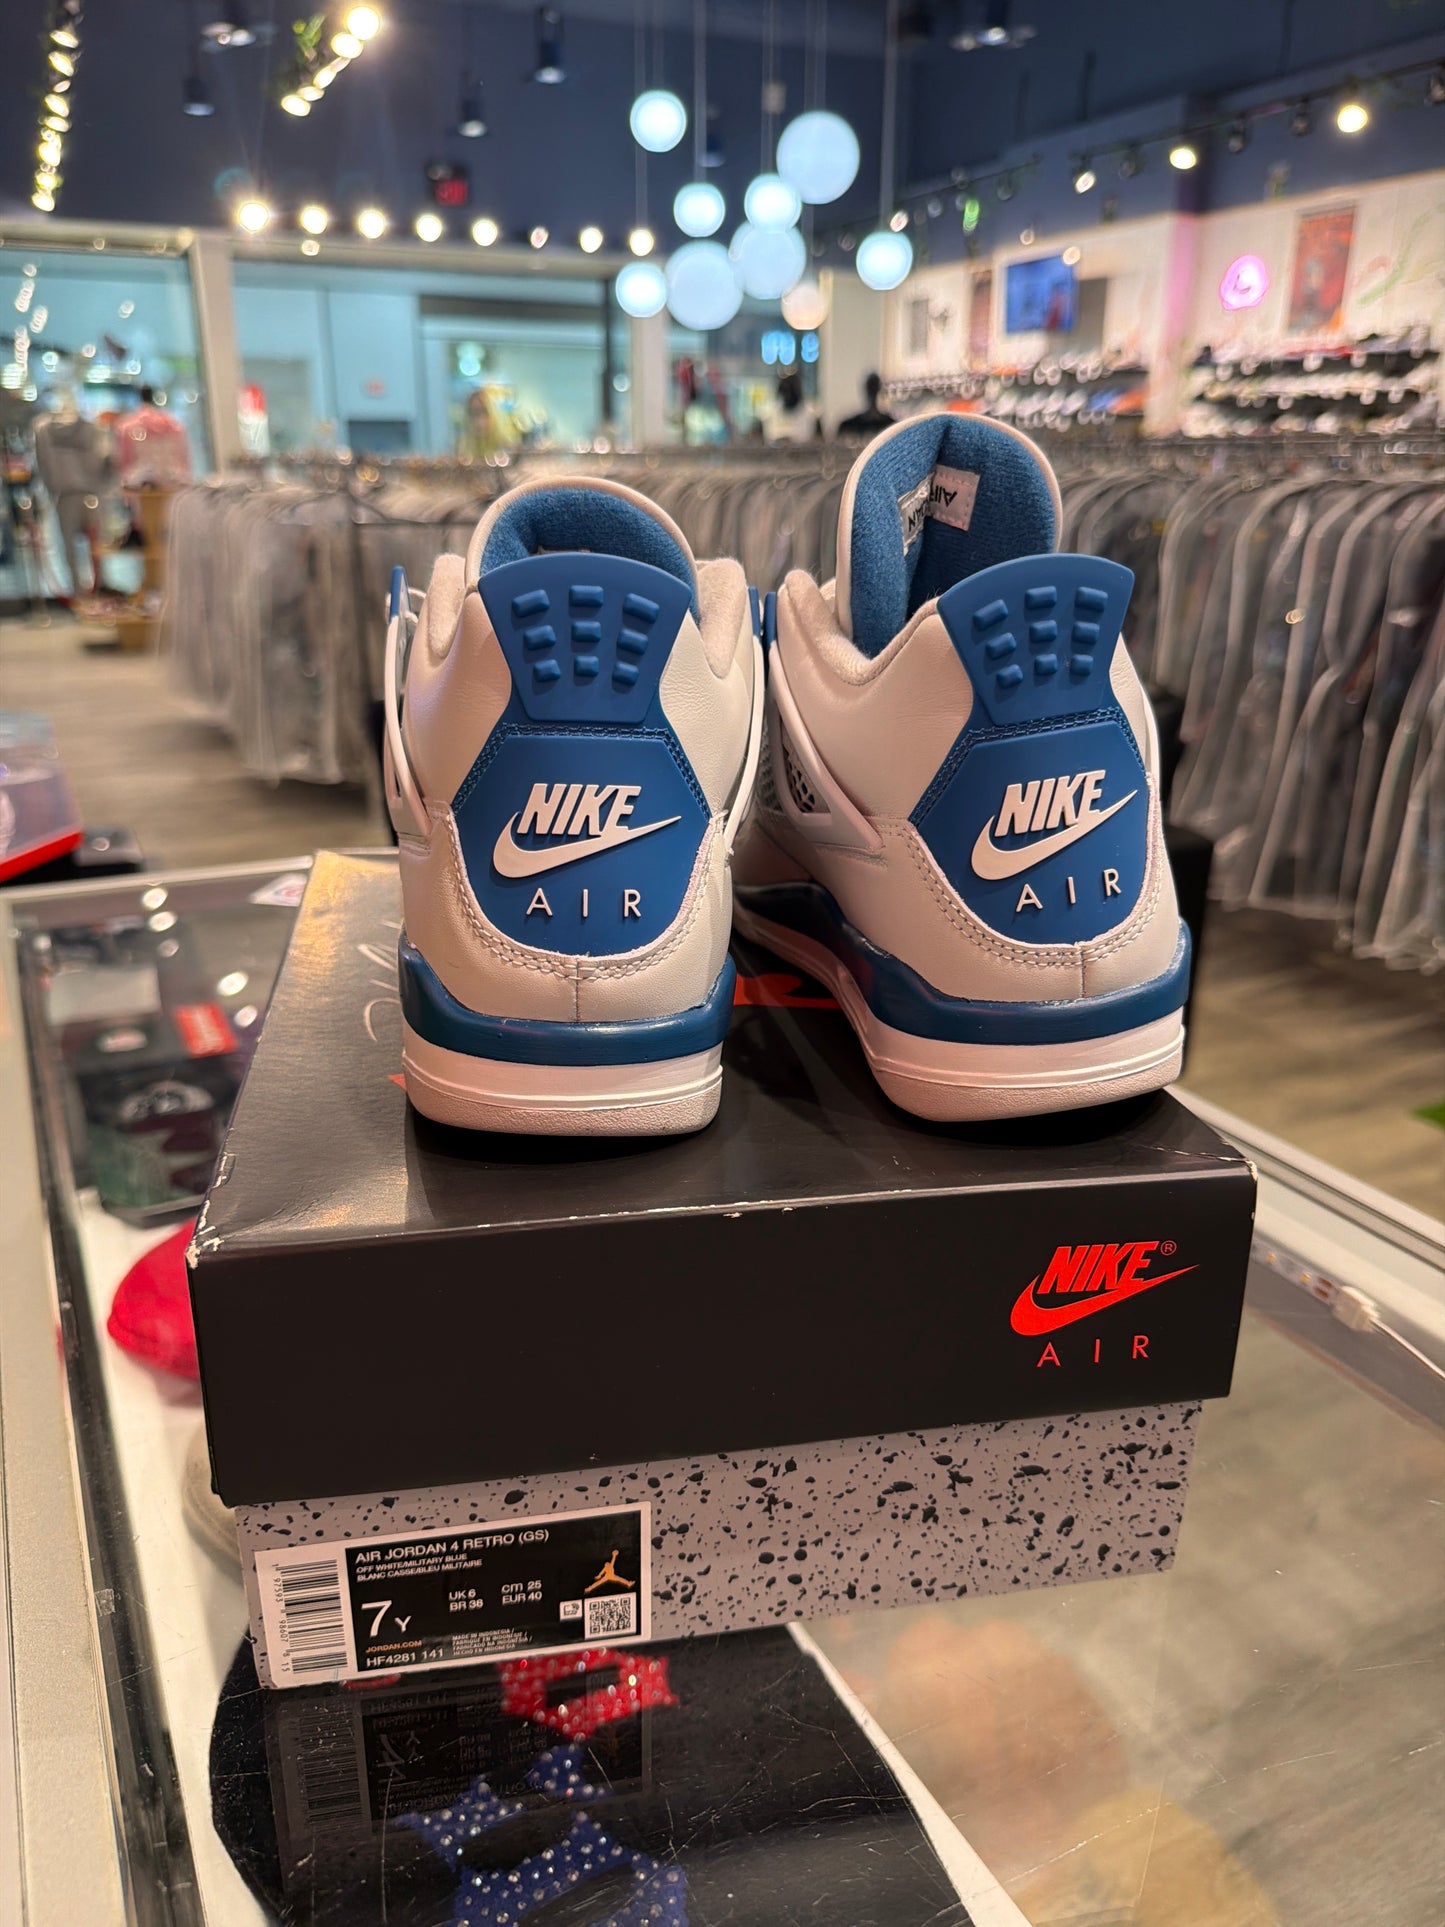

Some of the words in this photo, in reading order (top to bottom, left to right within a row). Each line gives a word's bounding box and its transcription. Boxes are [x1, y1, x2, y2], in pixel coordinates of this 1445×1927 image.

[517, 783, 642, 836] NIKE
[994, 769, 1106, 838] NIKE
[1015, 868, 1122, 913] AIR
[525, 888, 642, 918] AIR
[1036, 1240, 1160, 1295] NIKE
[1036, 1335, 1150, 1368] AIR
[355, 1551, 382, 1564] AIR
[384, 1542, 447, 1561] JORDAN
[450, 1541, 460, 1551] 4
[463, 1534, 515, 1549] RETRO
[519, 1529, 550, 1544] (GS)
[356, 1565, 374, 1574] OFF
[375, 1557, 443, 1571] WHITE/MILITARY
[445, 1553, 468, 1563] BLUE
[356, 1571, 386, 1582] BLANC
[441, 1559, 483, 1571] MILITAIRE
[273, 1577, 284, 1603] 97593
[449, 1590, 467, 1601] UK
[468, 1589, 476, 1598] 6
[527, 1580, 542, 1590] 25
[449, 1602, 467, 1612] BR
[468, 1599, 484, 1609] 38
[502, 1593, 526, 1605] EUR
[527, 1591, 543, 1601] 40
[361, 1600, 392, 1637] 7
[394, 1615, 412, 1633] Y
[278, 1620, 289, 1643] 98607
[365, 1640, 423, 1654] JORDAN.COM
[366, 1652, 416, 1667] HF4281
[422, 1648, 444, 1661] 141
